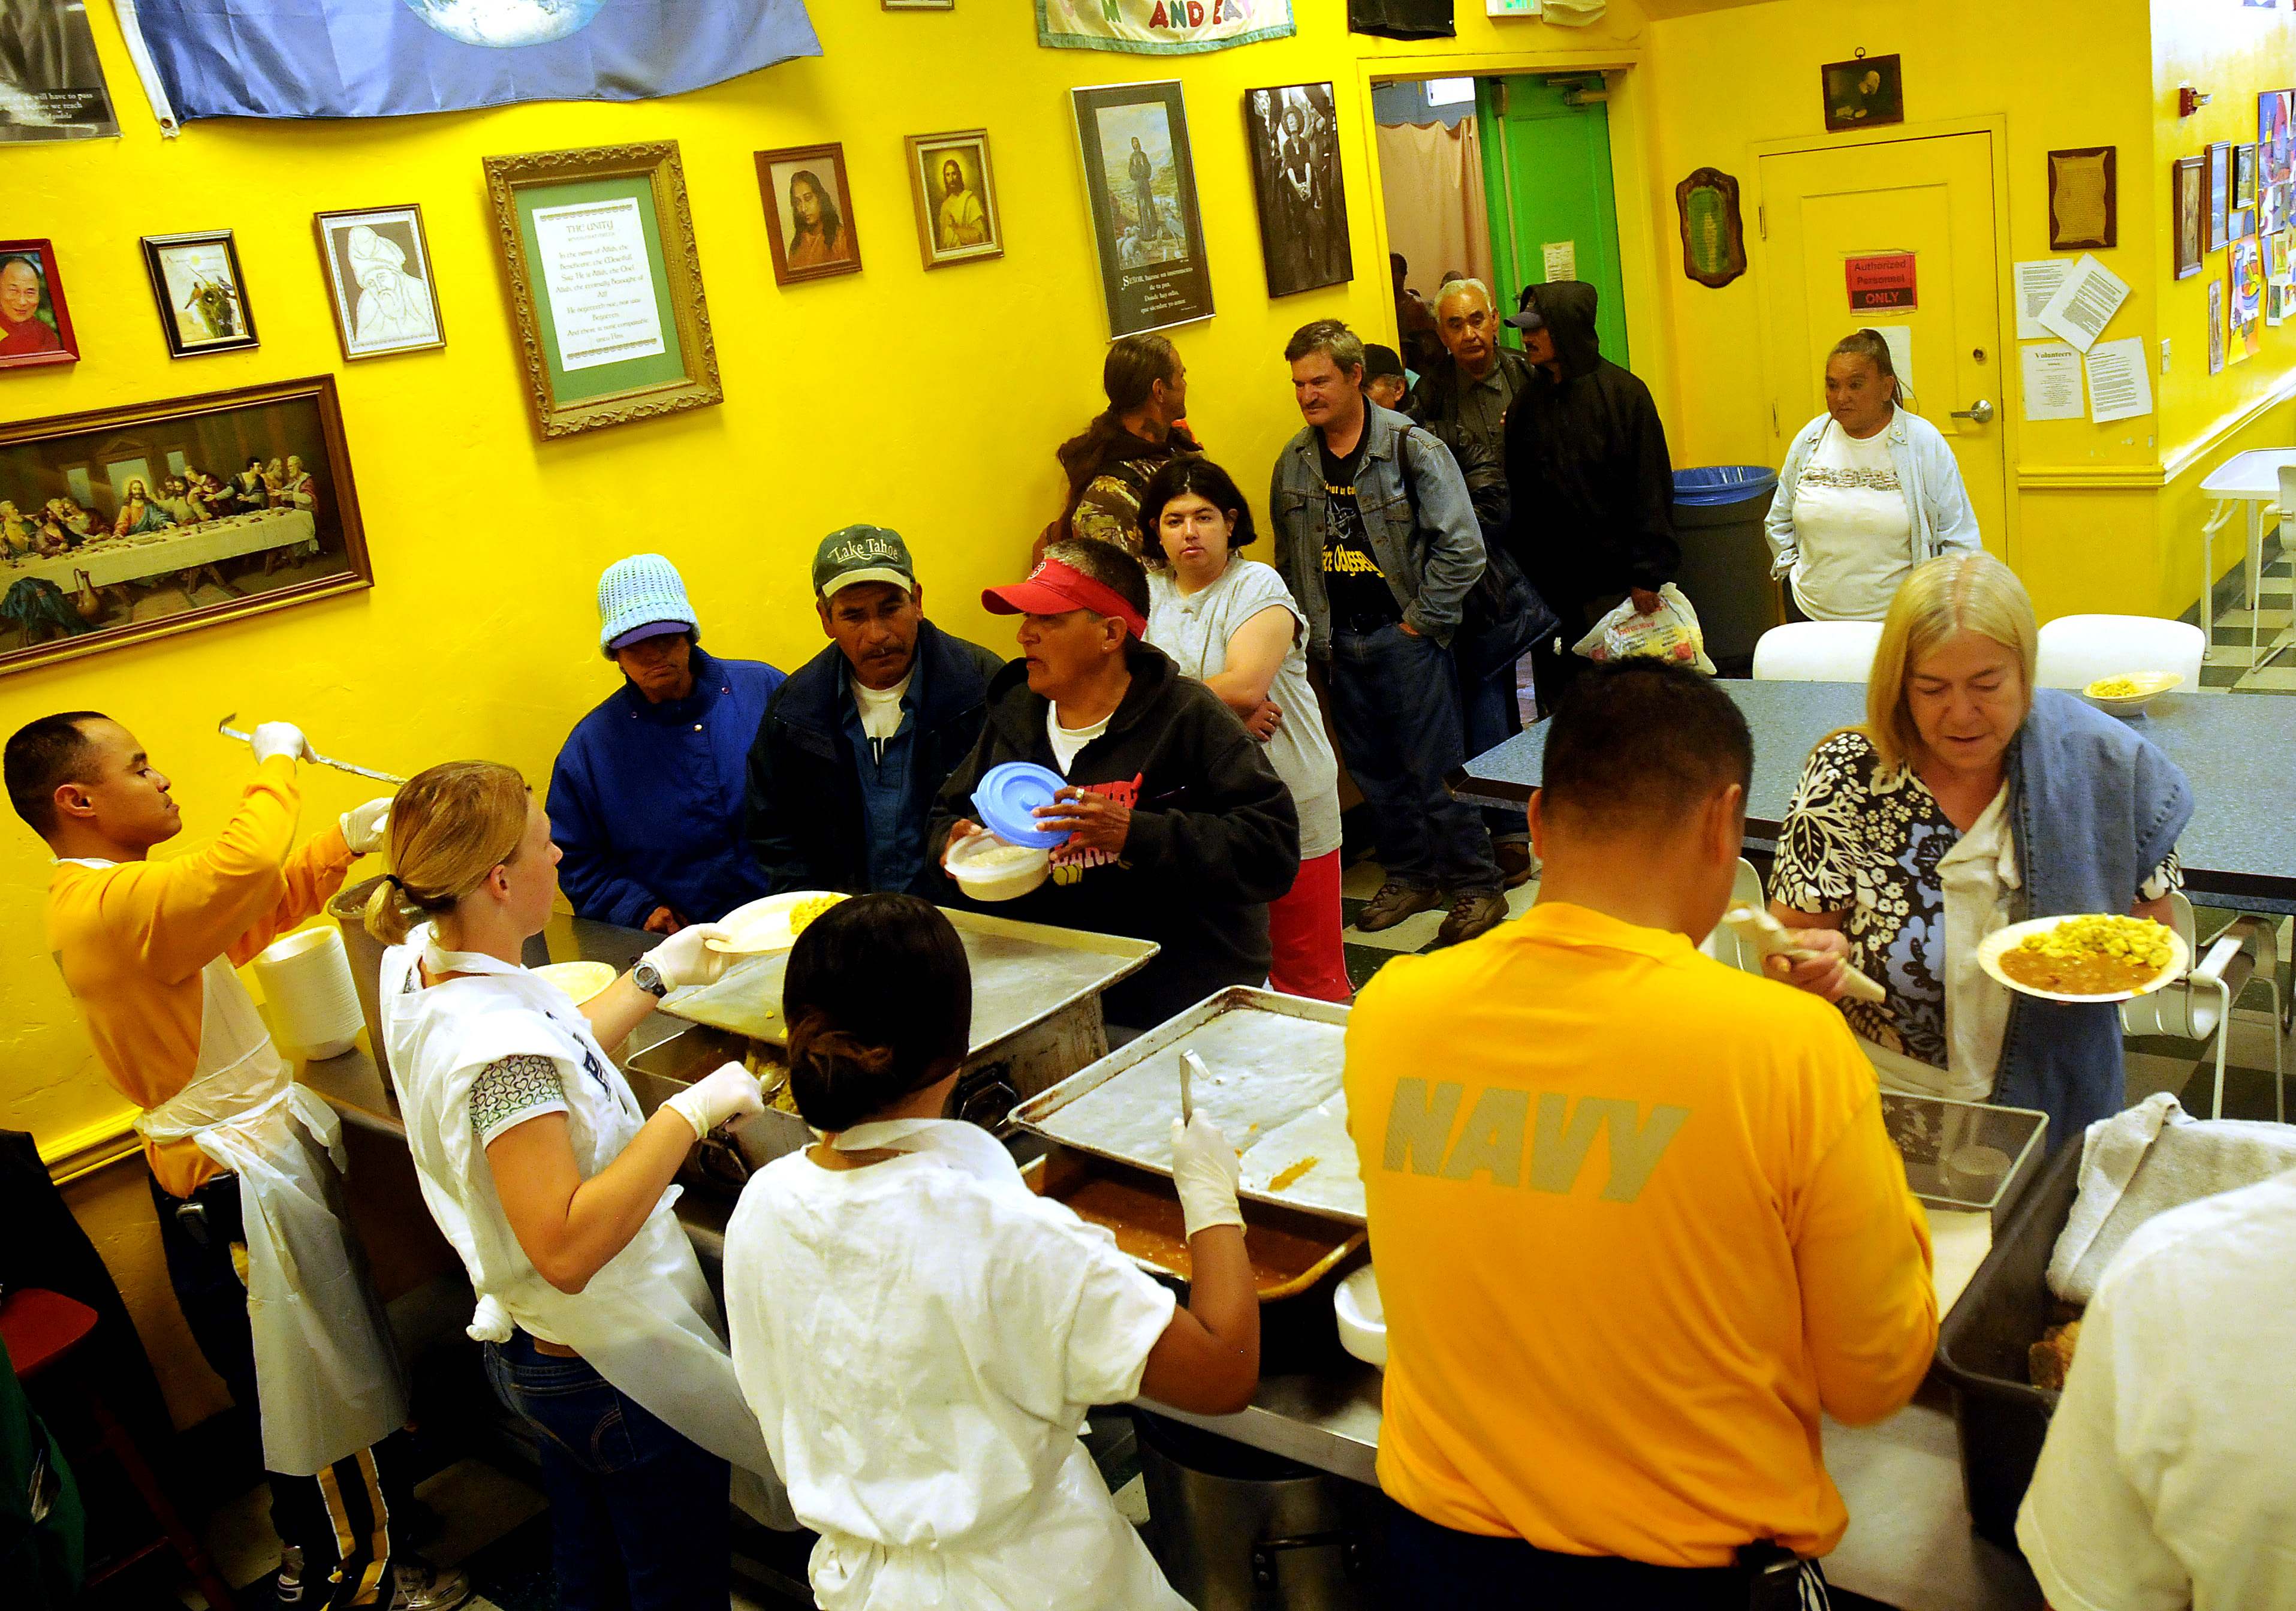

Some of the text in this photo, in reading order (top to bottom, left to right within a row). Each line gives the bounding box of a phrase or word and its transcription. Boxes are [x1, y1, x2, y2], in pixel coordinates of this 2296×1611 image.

[1149, 0, 1204, 28] AND
[587, 219, 614, 231] UNITY
[1855, 260, 1906, 271] Authorized
[1857, 273, 1905, 284] Personnel
[1866, 291, 1899, 304] ONLY
[827, 538, 898, 561] Lake Tahoe
[1334, 543, 1385, 578] Odyssey
[1382, 1077, 1694, 1203] NAVY
